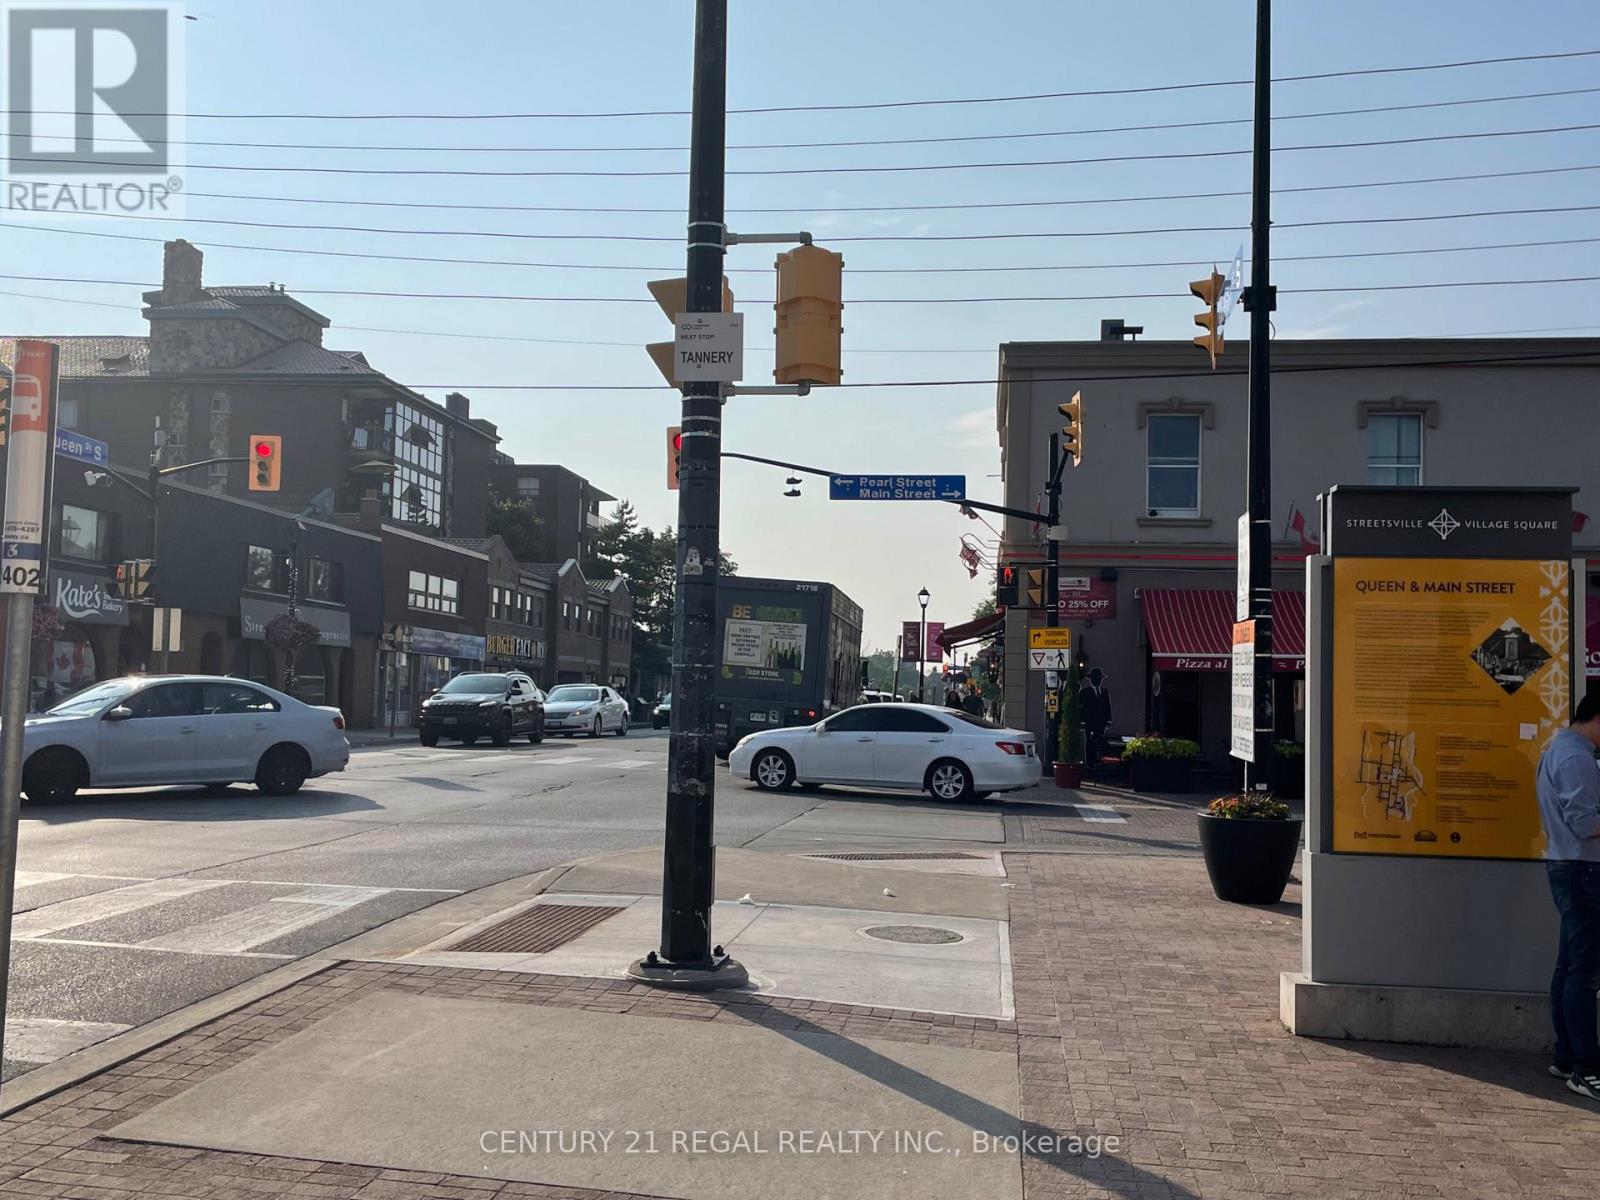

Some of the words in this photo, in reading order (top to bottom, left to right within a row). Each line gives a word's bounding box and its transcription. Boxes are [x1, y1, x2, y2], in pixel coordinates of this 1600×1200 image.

[680, 351, 734, 364] TANNERY
[56, 435, 83, 456] ueen
[94, 445, 103, 461] S
[859, 476, 893, 489] Pearl
[895, 477, 937, 488] Street
[859, 488, 891, 499] Main
[894, 487, 937, 499] Street
[1346, 519, 1423, 529] STREETSVILLE
[1464, 520, 1510, 529] VILLAGE
[1513, 521, 1559, 530] SQUARE
[1355, 580, 1405, 594] QUEEN
[1410, 581, 1420, 593] &
[1423, 581, 1462, 593] MAIN
[1466, 582, 1516, 594] STREET
[56, 577, 103, 618] Kate's
[1068, 600, 1089, 609] 25%
[1089, 600, 1110, 609] OFF
[486, 634, 515, 656] BURGER
[1175, 658, 1211, 669] Pizza
[1214, 660, 1228, 669] al
